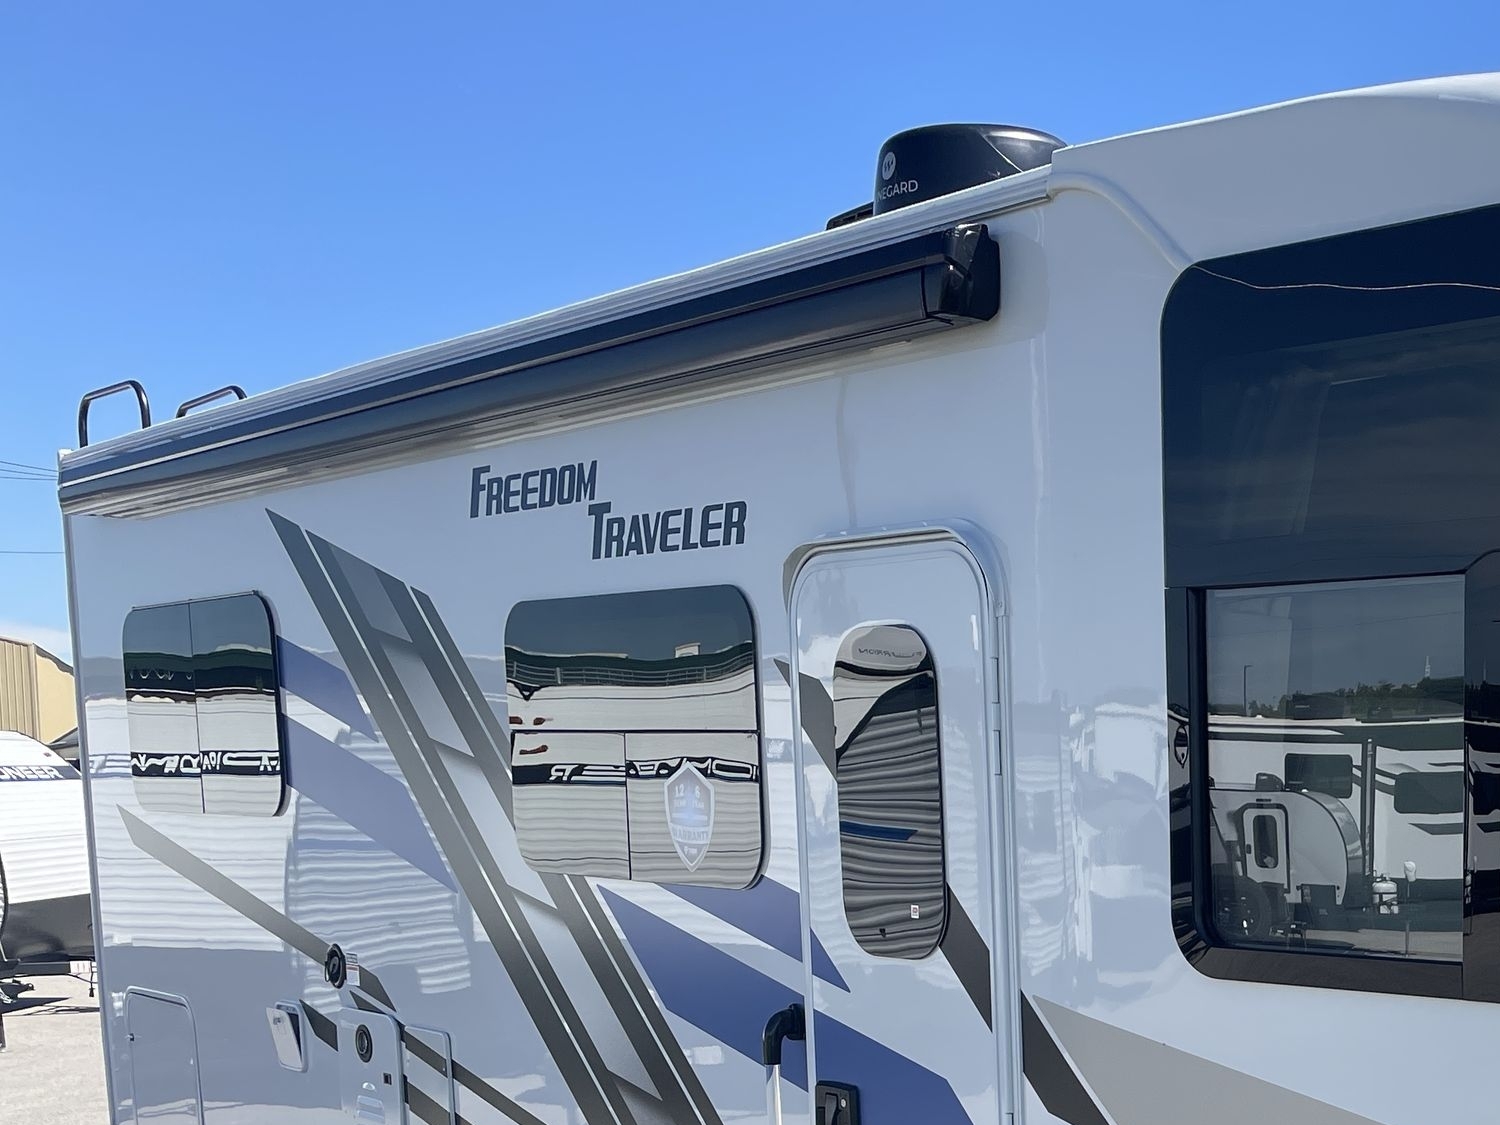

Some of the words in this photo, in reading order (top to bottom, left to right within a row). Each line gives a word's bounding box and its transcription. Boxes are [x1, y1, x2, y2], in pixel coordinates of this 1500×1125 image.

[876, 180, 919, 203] NEGARD
[470, 460, 598, 519] FREEDOM
[588, 500, 748, 560] TRAVELER
